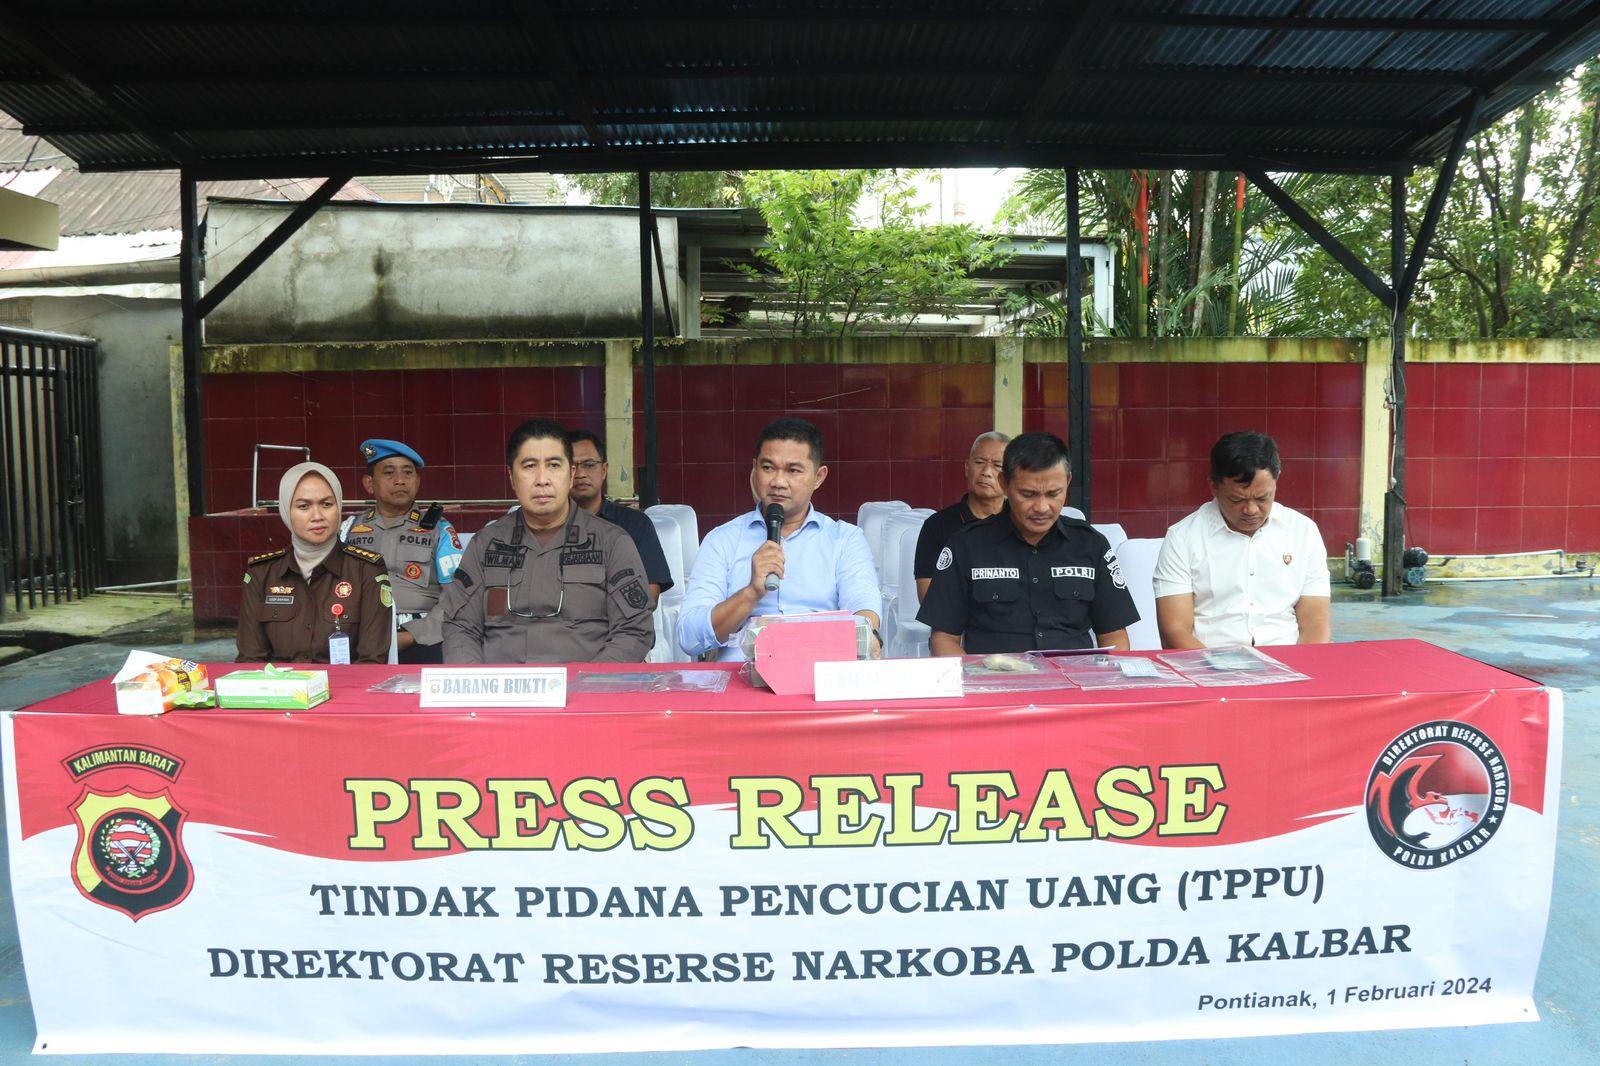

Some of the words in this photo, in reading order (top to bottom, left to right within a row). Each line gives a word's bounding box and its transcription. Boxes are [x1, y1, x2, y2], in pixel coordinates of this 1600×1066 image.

[399, 534, 432, 547] POLRI
[973, 568, 1018, 579] PRINANTO
[1054, 567, 1094, 578] POLRI
[442, 677, 499, 694] BARANG
[503, 677, 548, 694] BUKTI
[73, 749, 137, 774] KALIMANTAN
[139, 751, 175, 773] BARAT
[1382, 725, 1448, 767] DIREKTORAT
[1451, 726, 1495, 758] RESERSE
[1488, 756, 1507, 812] NARKOBA
[343, 776, 694, 852] PRESS
[728, 763, 1229, 849] RELEASE
[1393, 846, 1434, 866] POLDA
[1440, 827, 1491, 863] KALBAR
[310, 884, 499, 917] TINDAK
[515, 886, 703, 918] PIDANA
[719, 878, 1009, 917] PENCUCIAN
[1026, 872, 1161, 909] UANG
[1178, 864, 1324, 912] (TPPU)
[207, 948, 525, 983] DIREKTORAT
[542, 952, 775, 985] RESERSE
[792, 945, 1035, 982] NARKOBA
[1051, 936, 1210, 973] POLDA
[1225, 924, 1412, 963] KALBAR
[1198, 990, 1317, 1011] Pontianak,
[1326, 988, 1336, 1005] 1
[1344, 980, 1435, 1004] Februari
[1441, 977, 1492, 997] 2024
